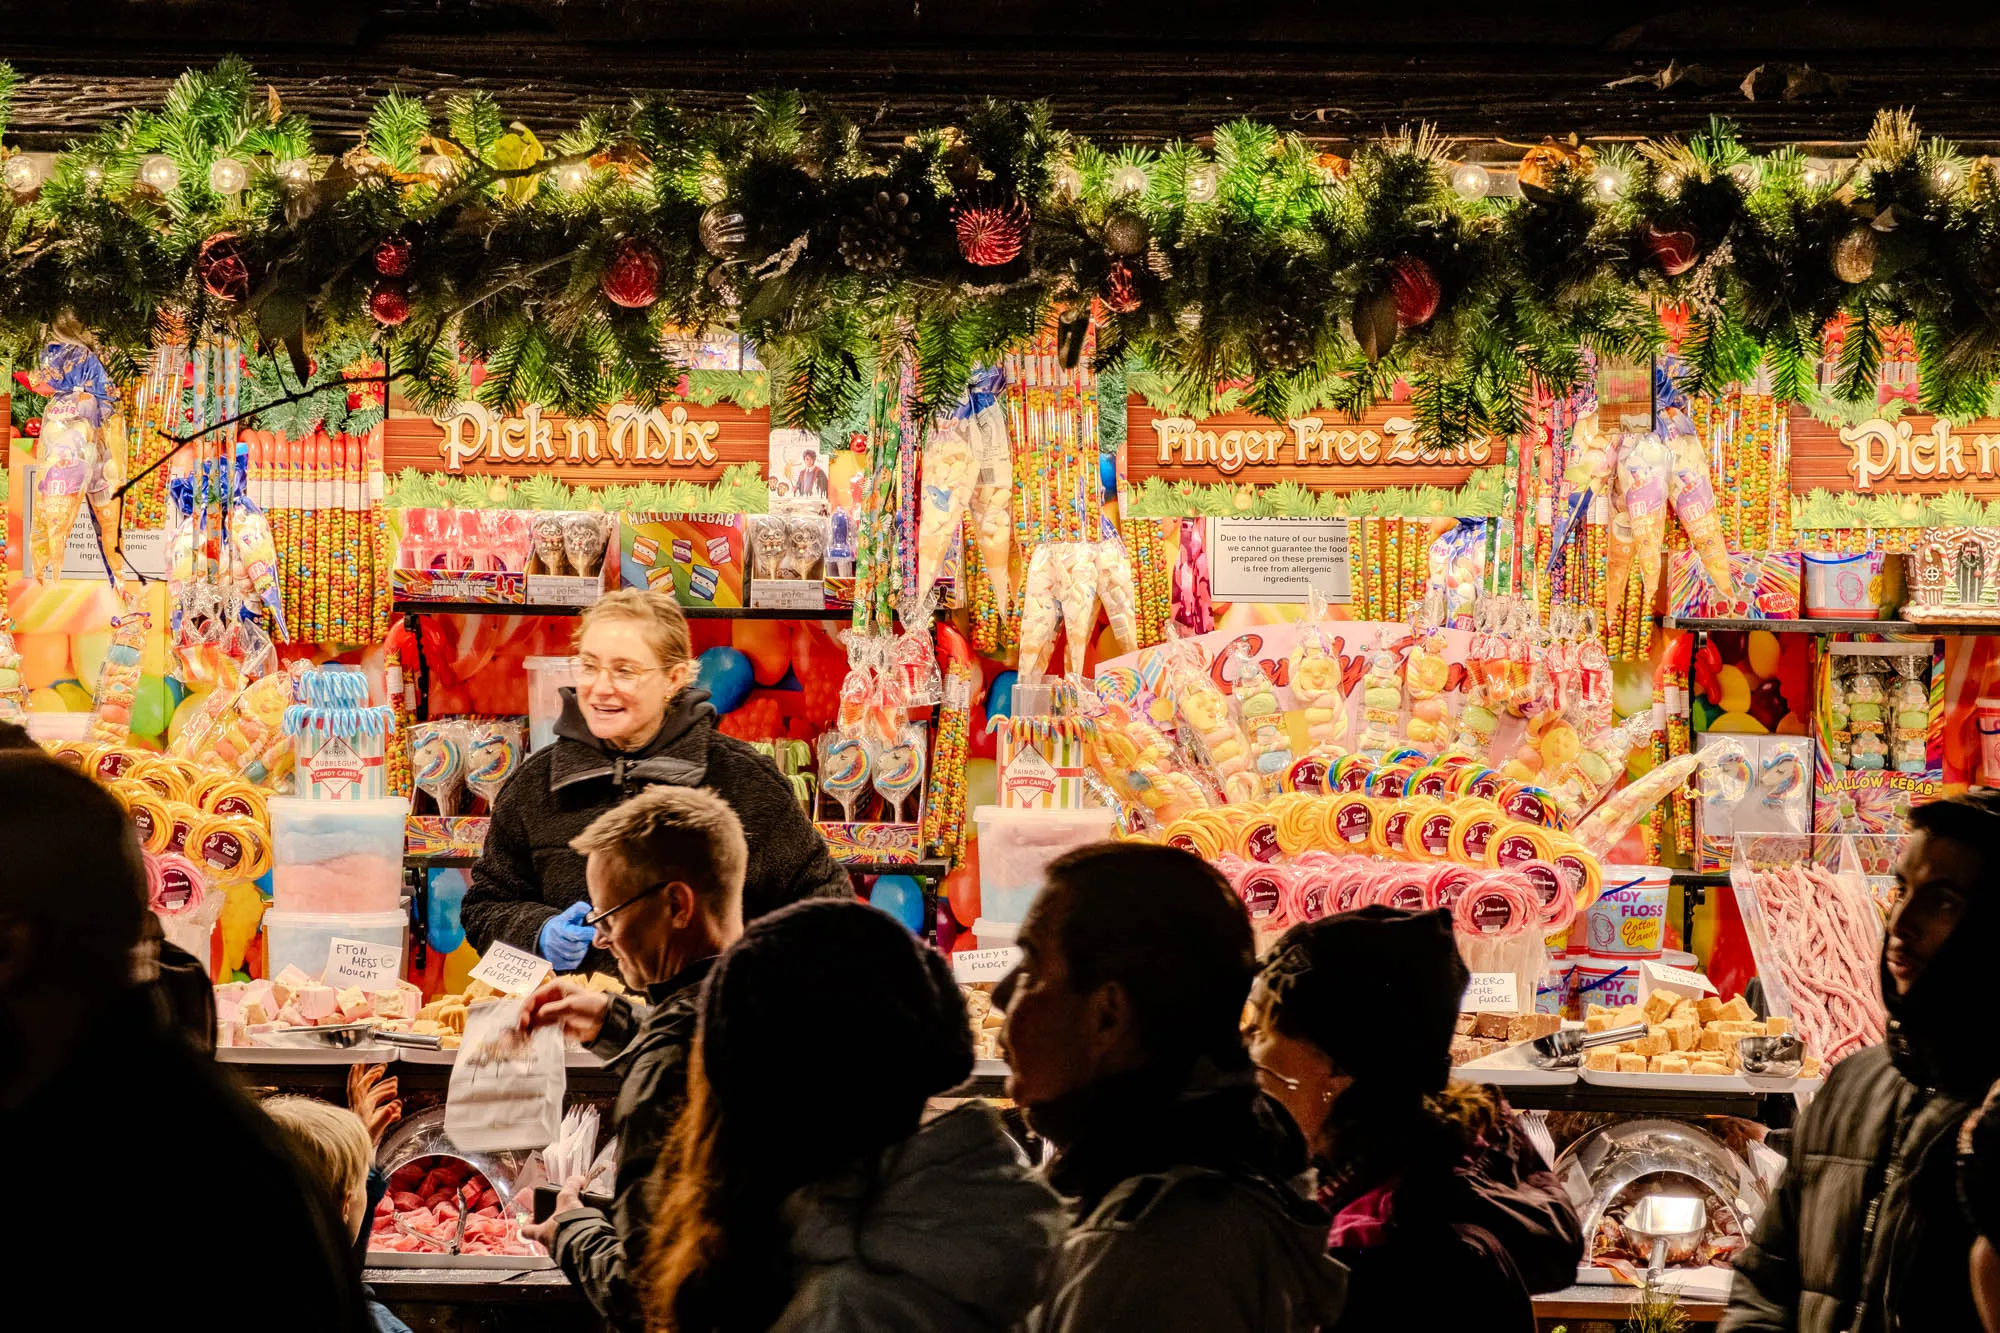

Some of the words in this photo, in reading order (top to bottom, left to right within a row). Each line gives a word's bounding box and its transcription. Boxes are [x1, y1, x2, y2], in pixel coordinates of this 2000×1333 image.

[434, 400, 557, 471] Pick
[565, 418, 601, 461] n
[606, 403, 718, 462] Mix
[1152, 416, 1285, 471] Finger
[1288, 417, 1379, 461] Free
[1840, 419, 1968, 489] Pick
[1220, 534, 1237, 542] Due
[1291, 535, 1301, 543] of
[125, 544, 148, 552] genic
[1271, 545, 1313, 554] guarantee
[1329, 545, 1348, 553] food
[79, 552, 100, 561] ingre
[1231, 555, 1268, 563] prepared
[1306, 556, 1345, 564] premises
[1252, 565, 1269, 573] free
[1270, 565, 1290, 573] from
[1292, 565, 1332, 574] allergenic
[1263, 575, 1312, 584] ingredients.
[1013, 768, 1047, 776] RAINBOW
[1823, 776, 1884, 795] MALLOW
[1889, 777, 1934, 795] KEBAB
[1599, 891, 1642, 903] ANDY
[1621, 904, 1664, 917] FLOSS
[1621, 920, 1657, 936] Cotton
[1626, 930, 1659, 946] Candy
[336, 943, 368, 955] ETON
[351, 956, 378, 969] MESS
[493, 948, 537, 970] CLOTTED
[496, 961, 533, 980] CREAM
[972, 961, 1008, 971] FUDGE
[338, 965, 380, 980] NOUGAT
[482, 966, 521, 986] FUDGE
[1478, 995, 1512, 1005] FUDGE
